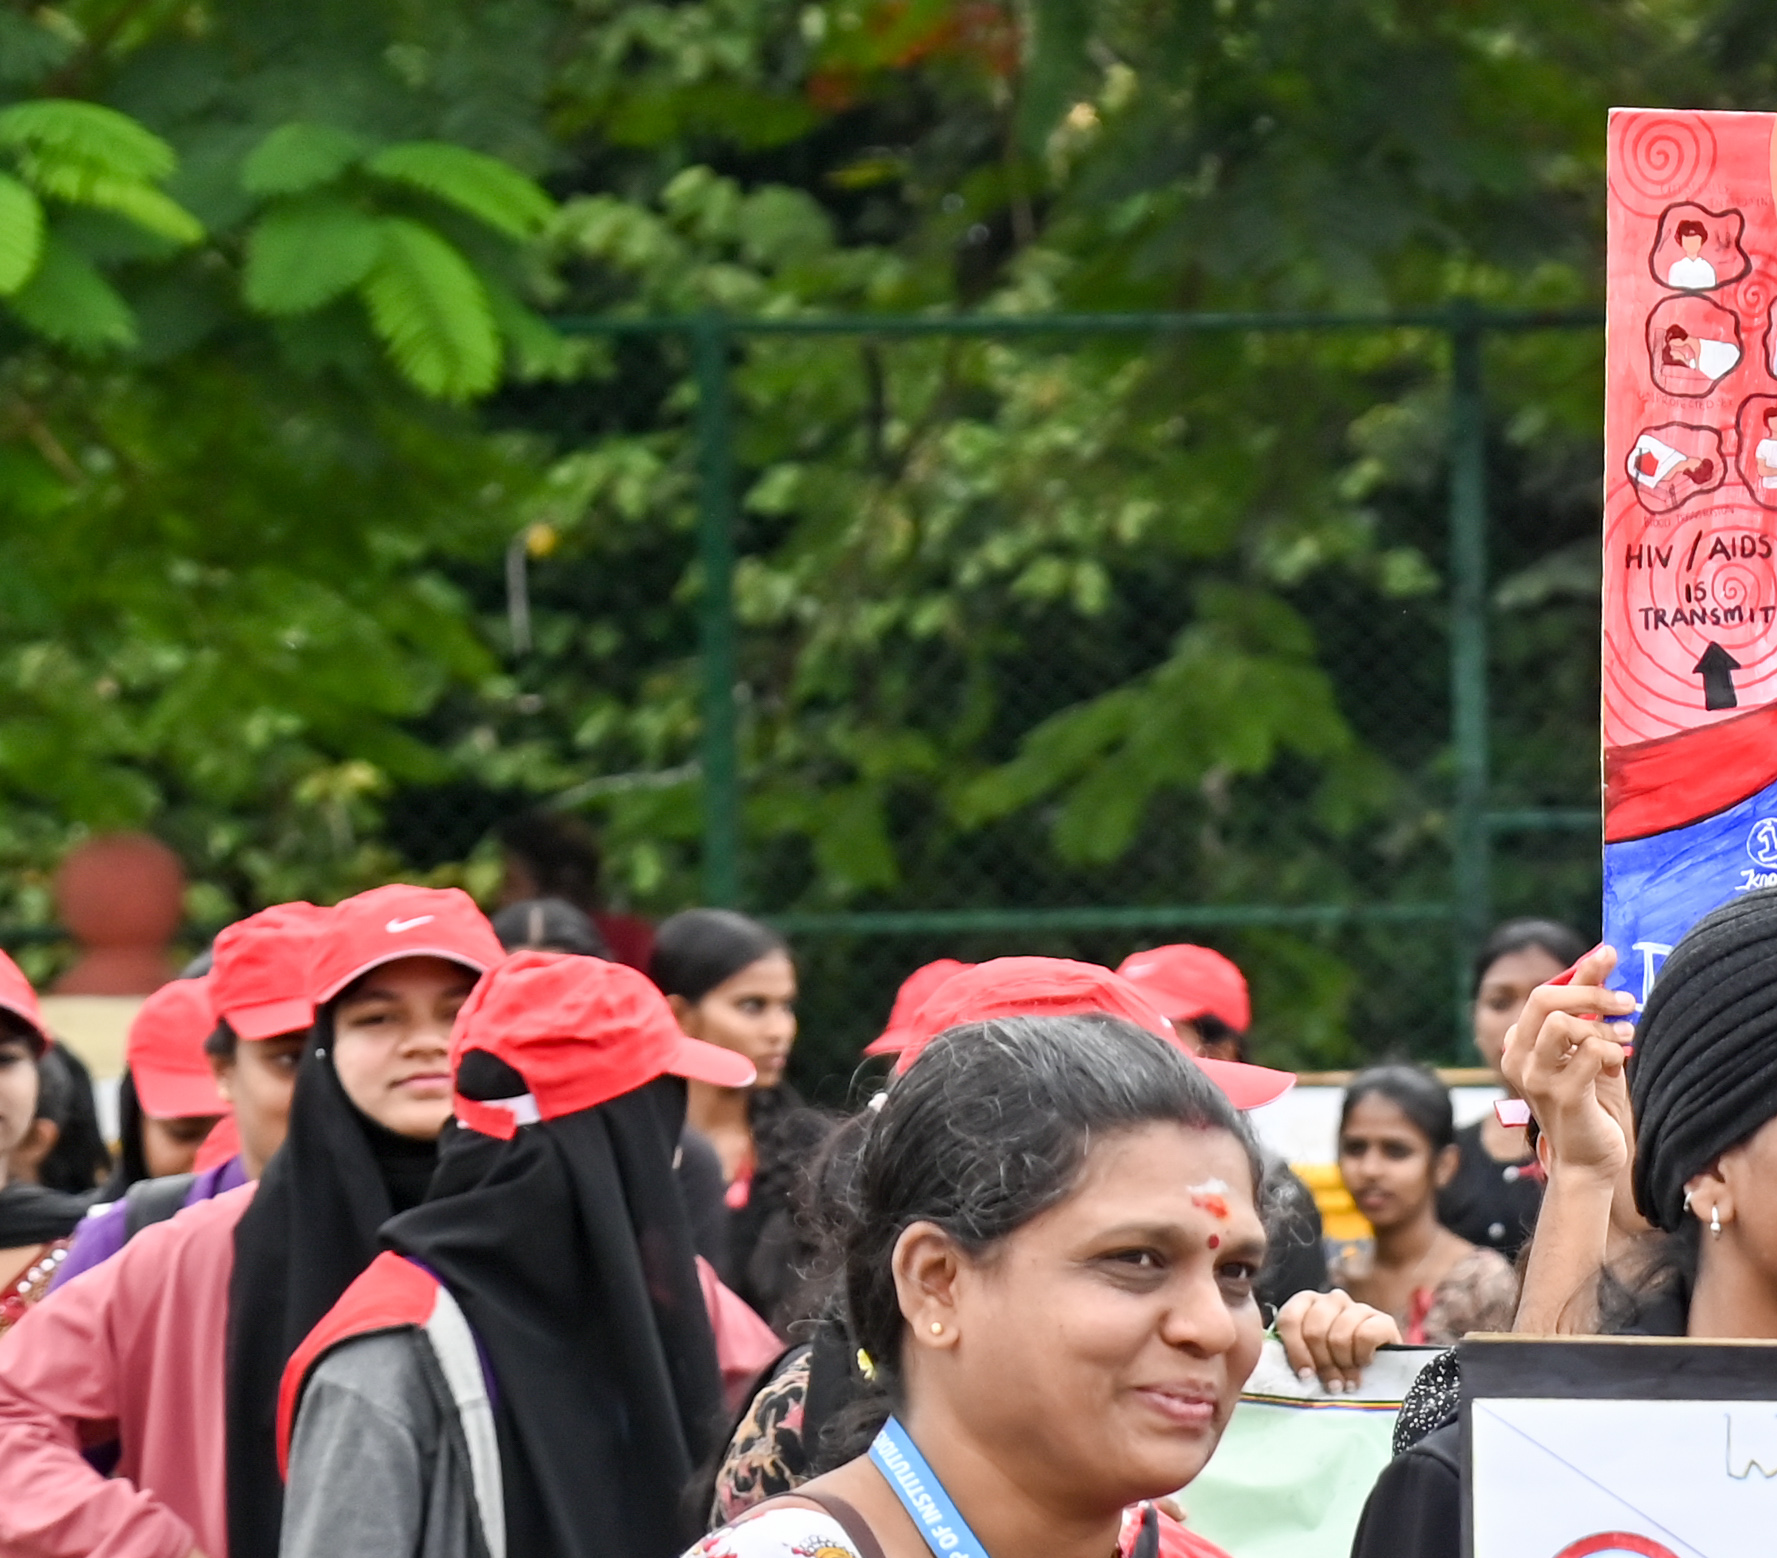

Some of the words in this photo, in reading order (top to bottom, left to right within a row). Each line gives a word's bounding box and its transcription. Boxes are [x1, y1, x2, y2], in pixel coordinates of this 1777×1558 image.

[1626, 544, 1673, 569] HIV
[1709, 535, 1772, 560] AIDS
[1686, 581, 1706, 603] IS
[931, 1525, 959, 1550] OF
